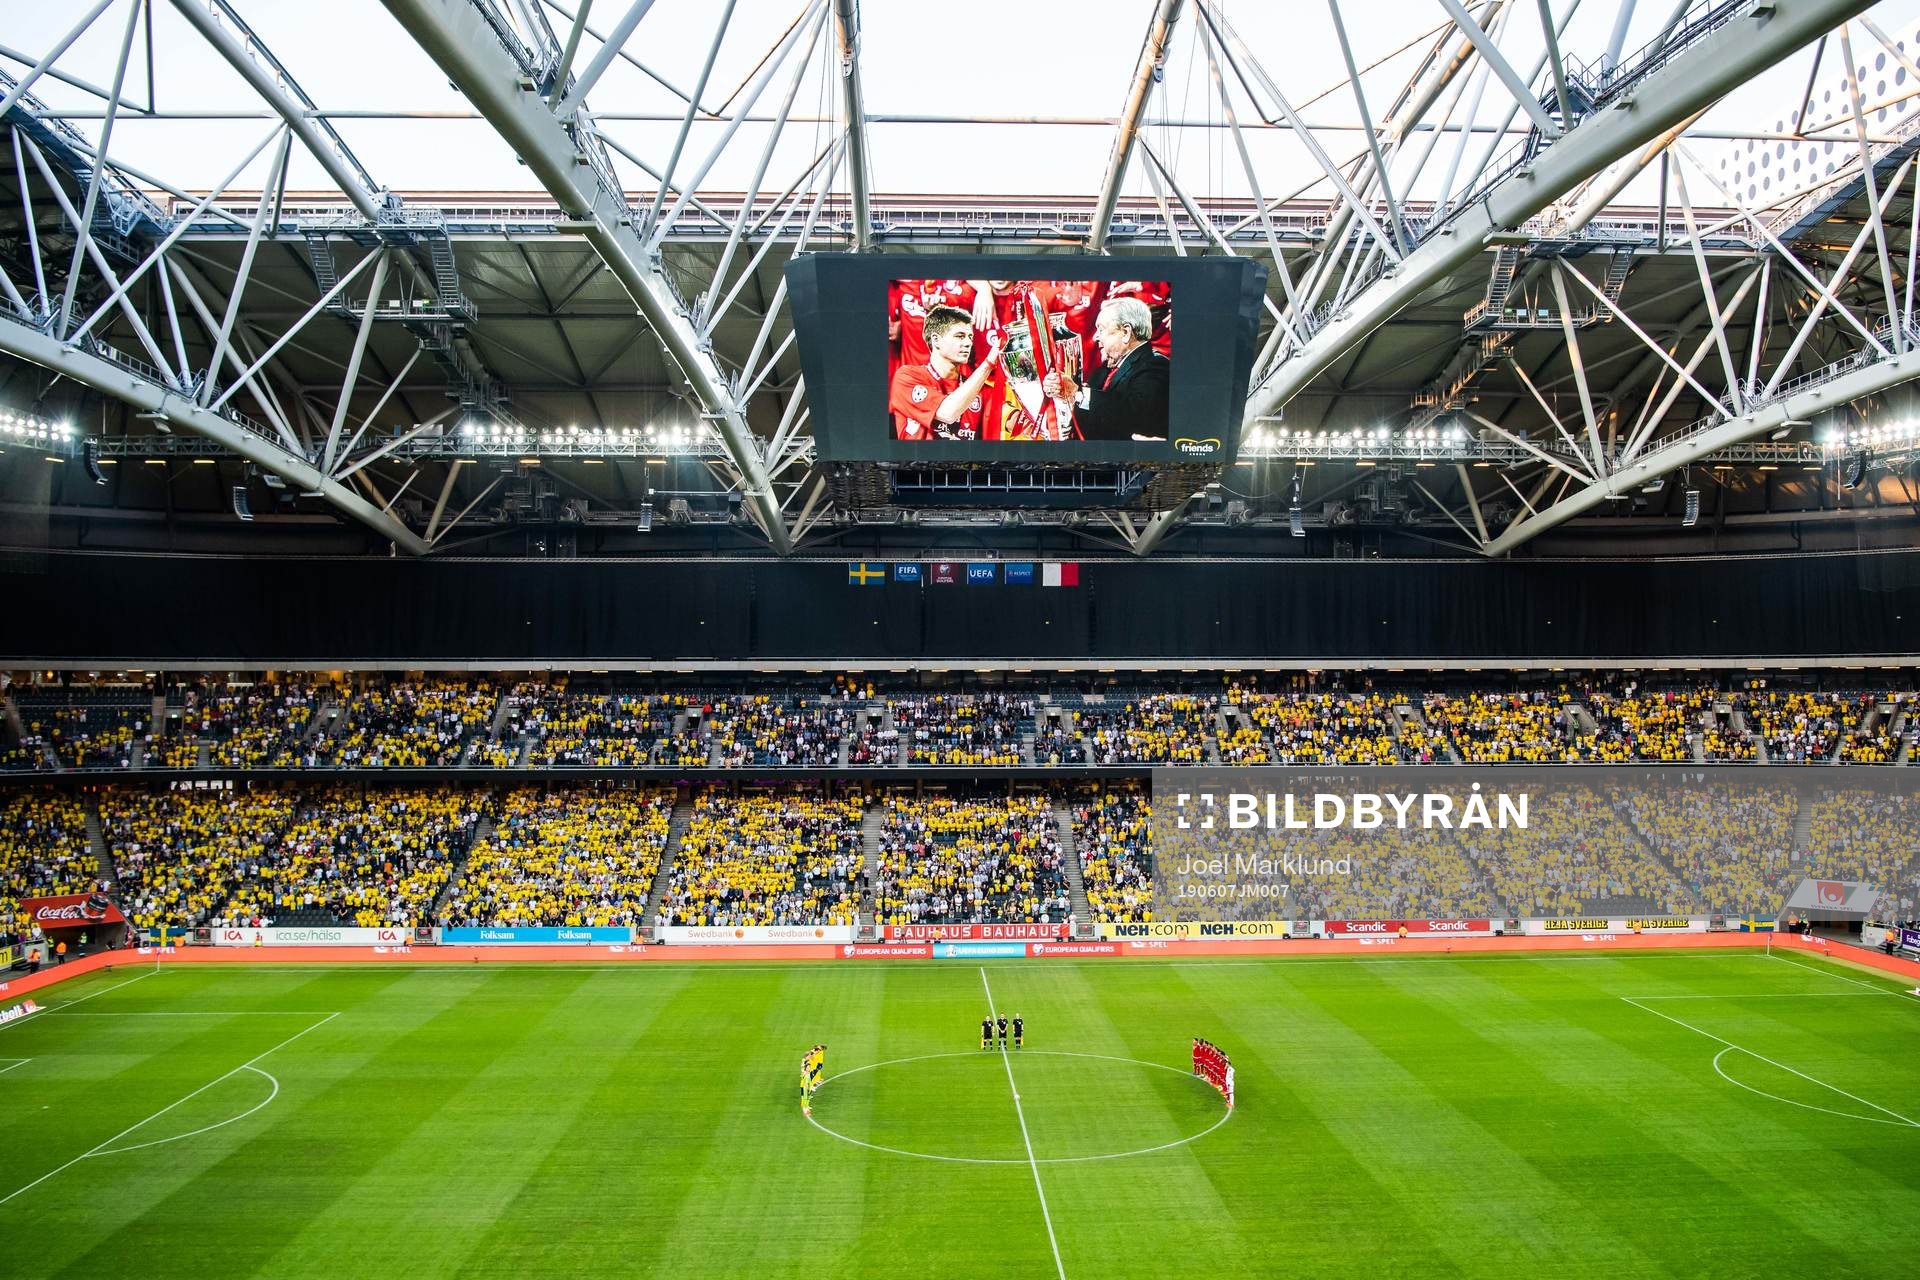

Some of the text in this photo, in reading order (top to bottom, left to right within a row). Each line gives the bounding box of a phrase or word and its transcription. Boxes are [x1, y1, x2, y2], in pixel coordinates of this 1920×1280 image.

[1180, 442, 1214, 453] friends
[898, 566, 917, 574] FIFA
[969, 569, 993, 578] UEFA
[1346, 921, 1387, 932] Scandic
[1429, 920, 1469, 931] Scandic
[1544, 919, 1608, 930] HEJA SVERIGE
[1650, 918, 1689, 928] SVERIGE
[224, 930, 243, 941] ICA
[276, 929, 341, 941] ica.se/hälsa
[378, 930, 397, 941] ICA
[480, 930, 515, 939] Folksam
[557, 930, 592, 939] Folksam
[688, 929, 733, 938] Swedbank
[767, 929, 813, 938] Swedbank
[893, 925, 1060, 938] BAUHAUS BAUHAUS
